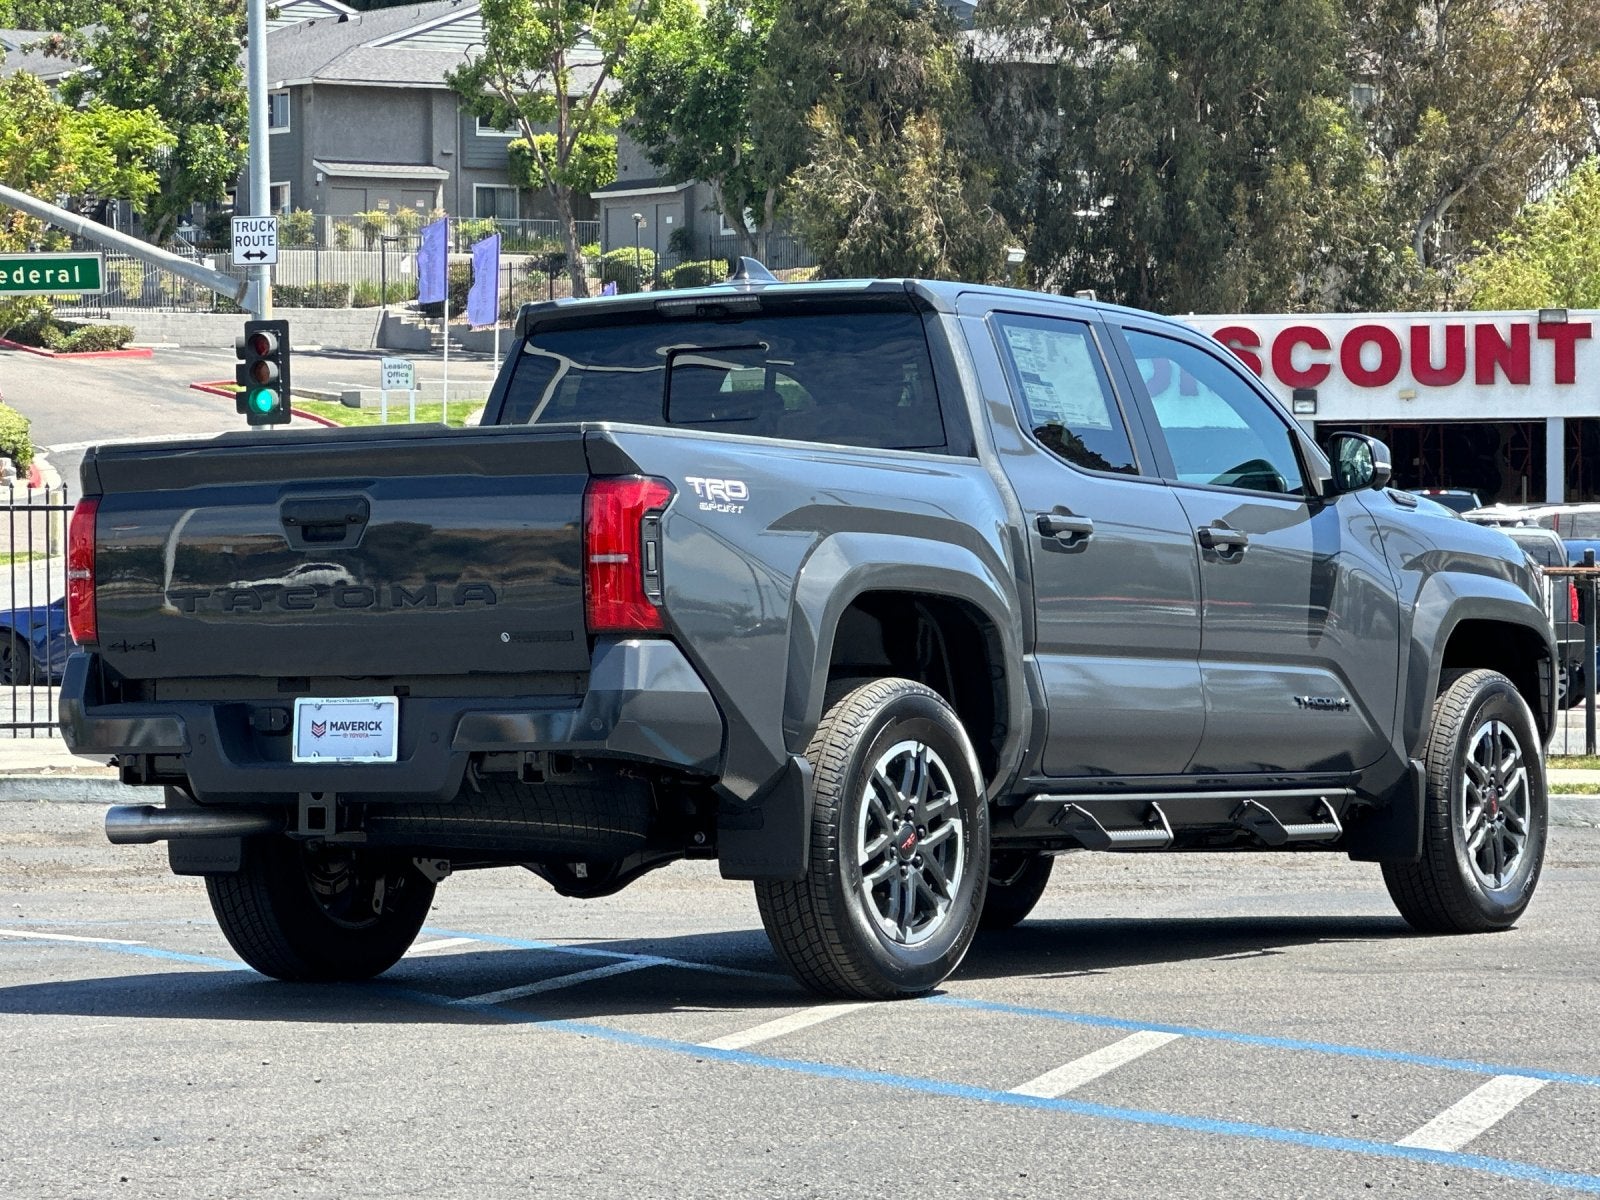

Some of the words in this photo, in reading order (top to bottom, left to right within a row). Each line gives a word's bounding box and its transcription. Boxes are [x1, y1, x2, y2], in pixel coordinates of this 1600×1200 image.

[235, 220, 275, 232] TRUCK
[235, 235, 275, 247] ROUTE
[383, 363, 413, 371] Leasing
[684, 476, 748, 502] TRD
[166, 583, 498, 613] TACOMA
[330, 721, 383, 731] MAVERICK
